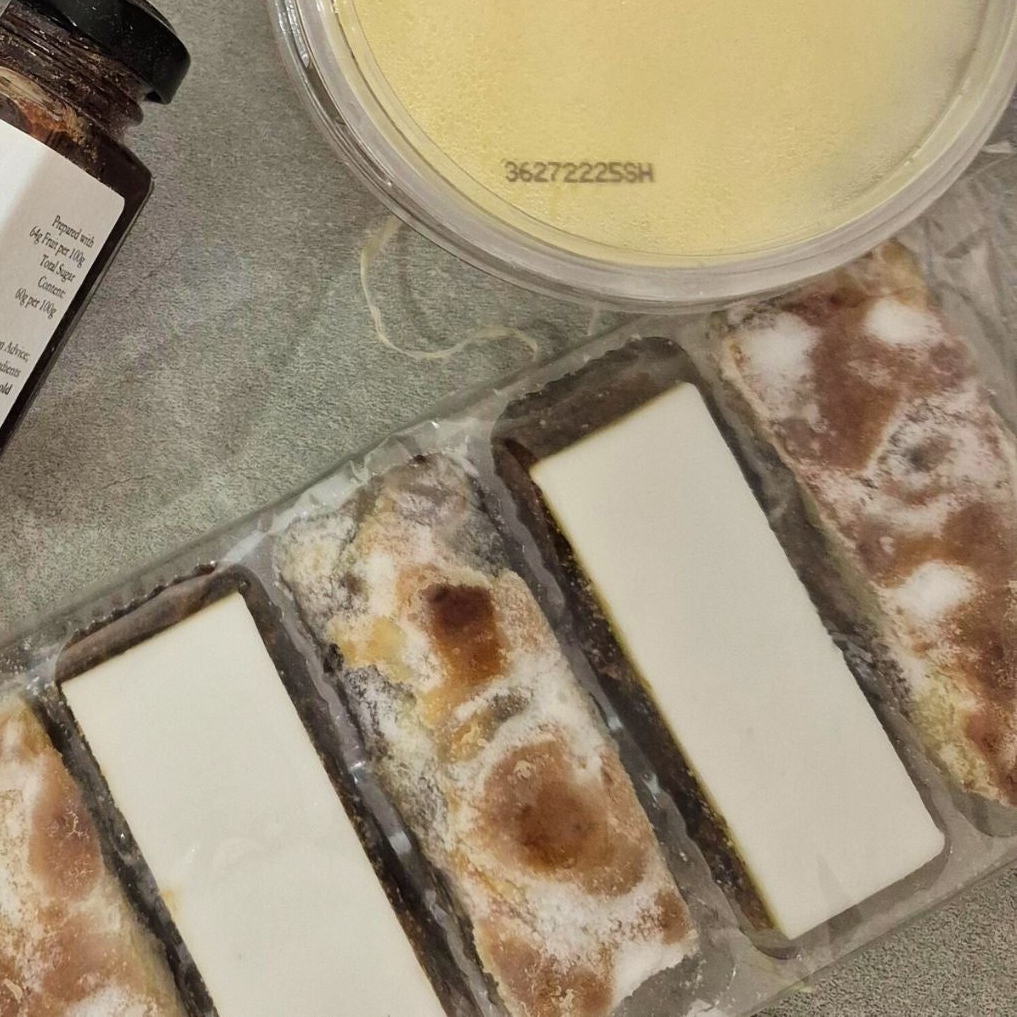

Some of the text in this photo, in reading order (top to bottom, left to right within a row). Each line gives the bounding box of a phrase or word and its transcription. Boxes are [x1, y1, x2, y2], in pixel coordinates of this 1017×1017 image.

[51, 214, 83, 240] Prepared
[54, 244, 70, 256] per
[39, 253, 59, 273] Total
[24, 295, 40, 309] per
